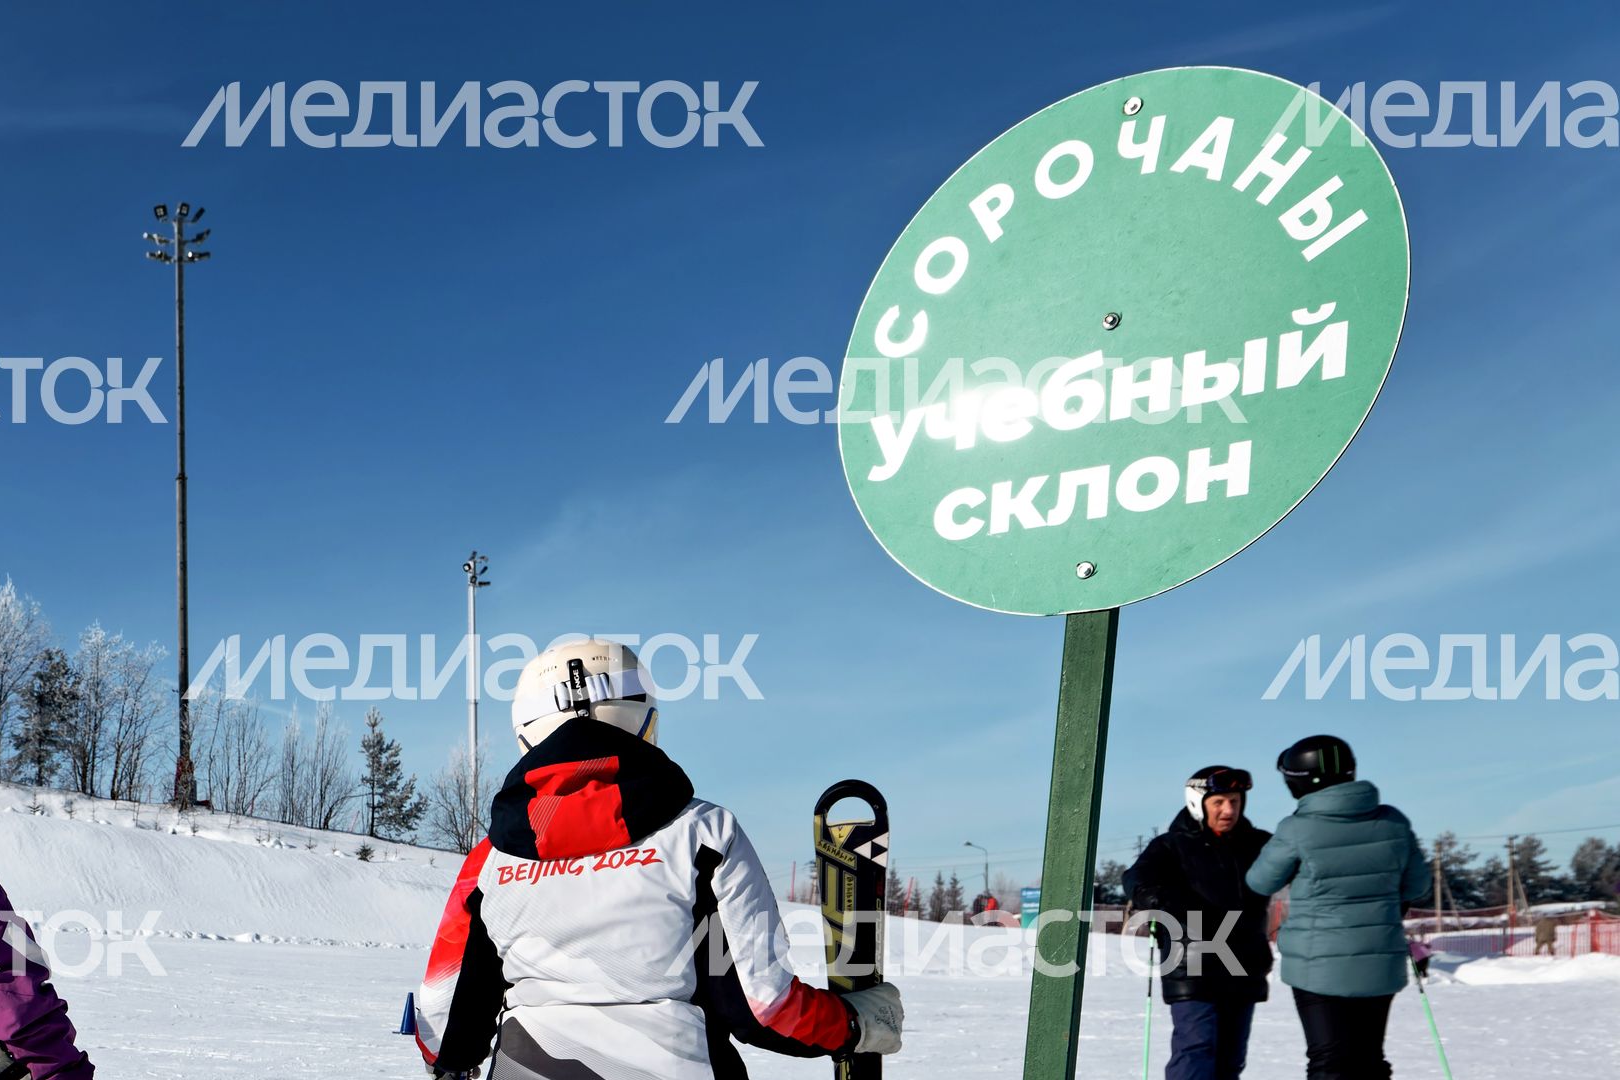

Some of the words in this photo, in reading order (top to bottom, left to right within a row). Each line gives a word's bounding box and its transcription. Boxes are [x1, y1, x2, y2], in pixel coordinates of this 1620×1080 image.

[874, 115, 1368, 358] СОРОЧАНЫ
[868, 302, 1350, 482] учебный
[933, 440, 1252, 541] склон
[572, 669, 584, 701] LANGE
[497, 857, 584, 885] BEIJING
[593, 848, 664, 872] 2022
